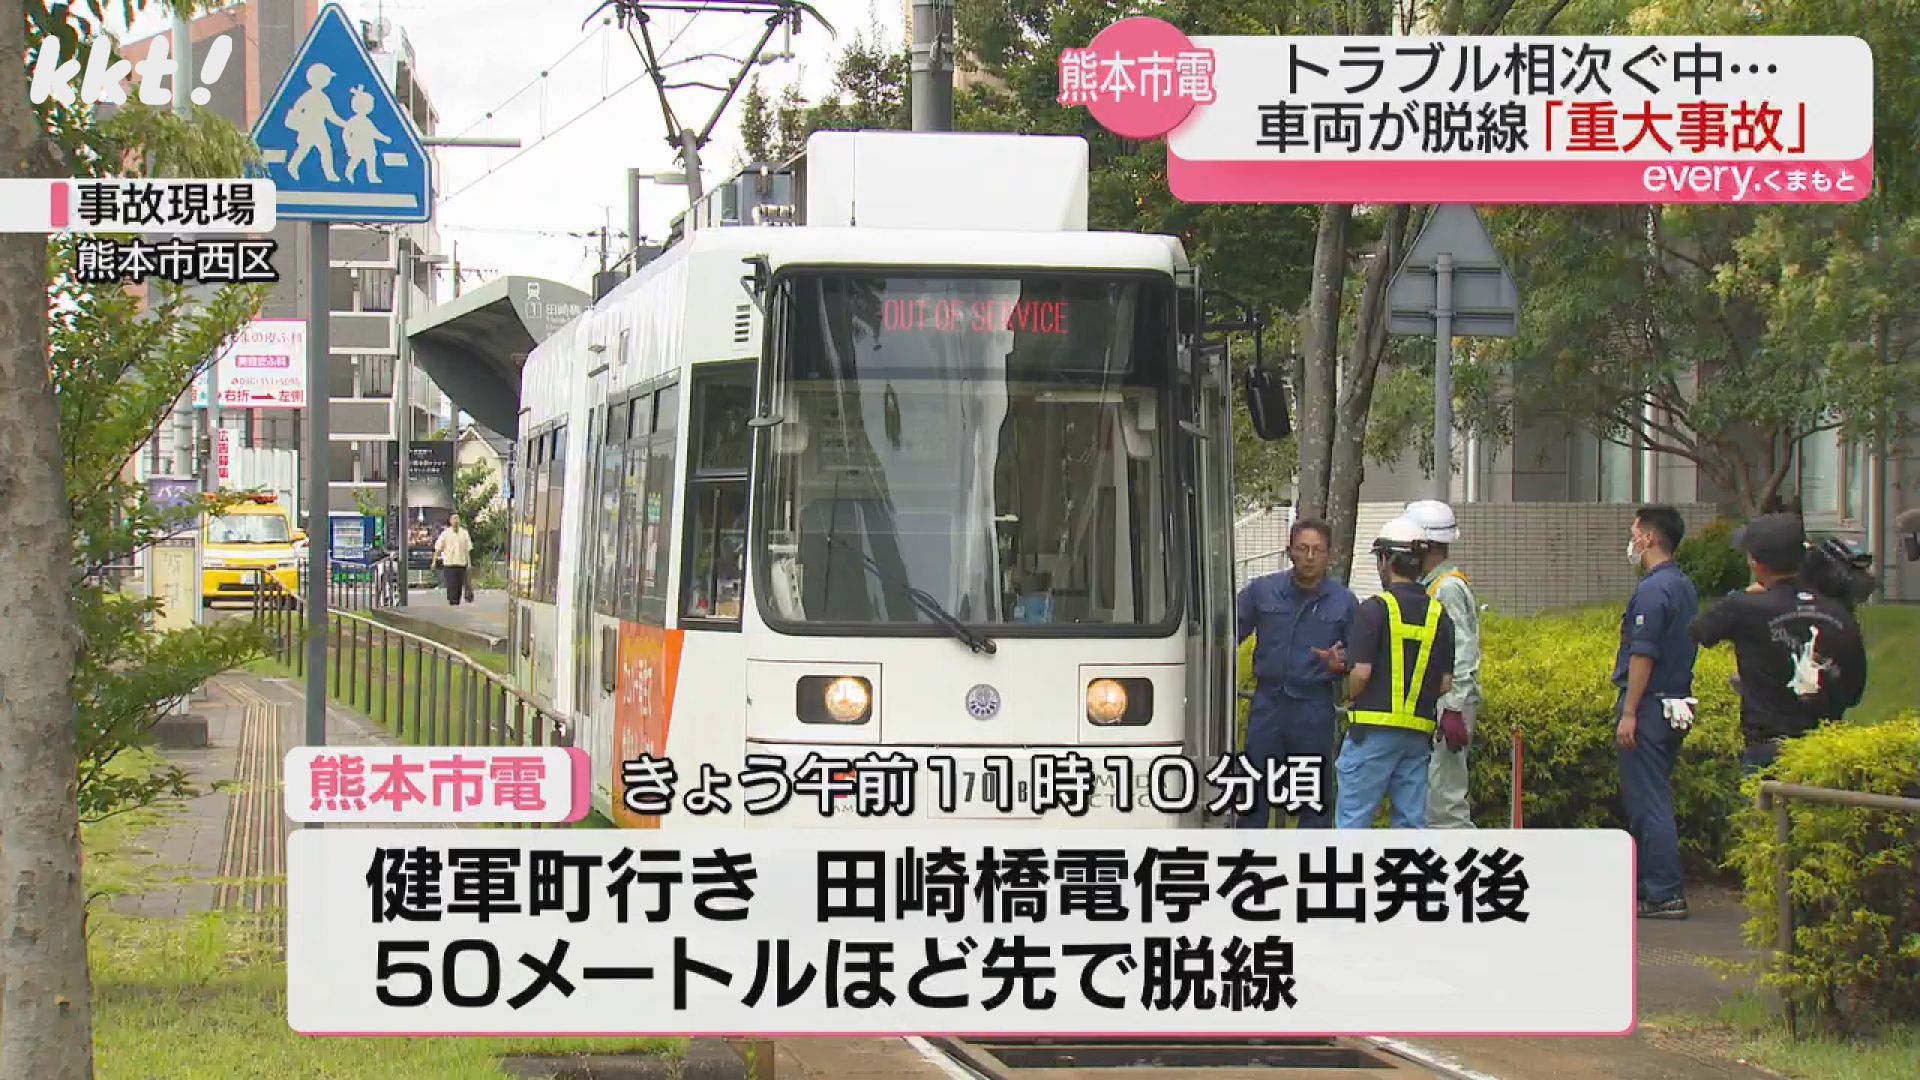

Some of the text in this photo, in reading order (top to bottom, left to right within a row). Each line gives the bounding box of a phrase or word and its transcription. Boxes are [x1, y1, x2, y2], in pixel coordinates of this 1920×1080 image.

[883, 299, 1069, 334] OUT OF SERVICE
[224, 389, 304, 403] 右折 左側
